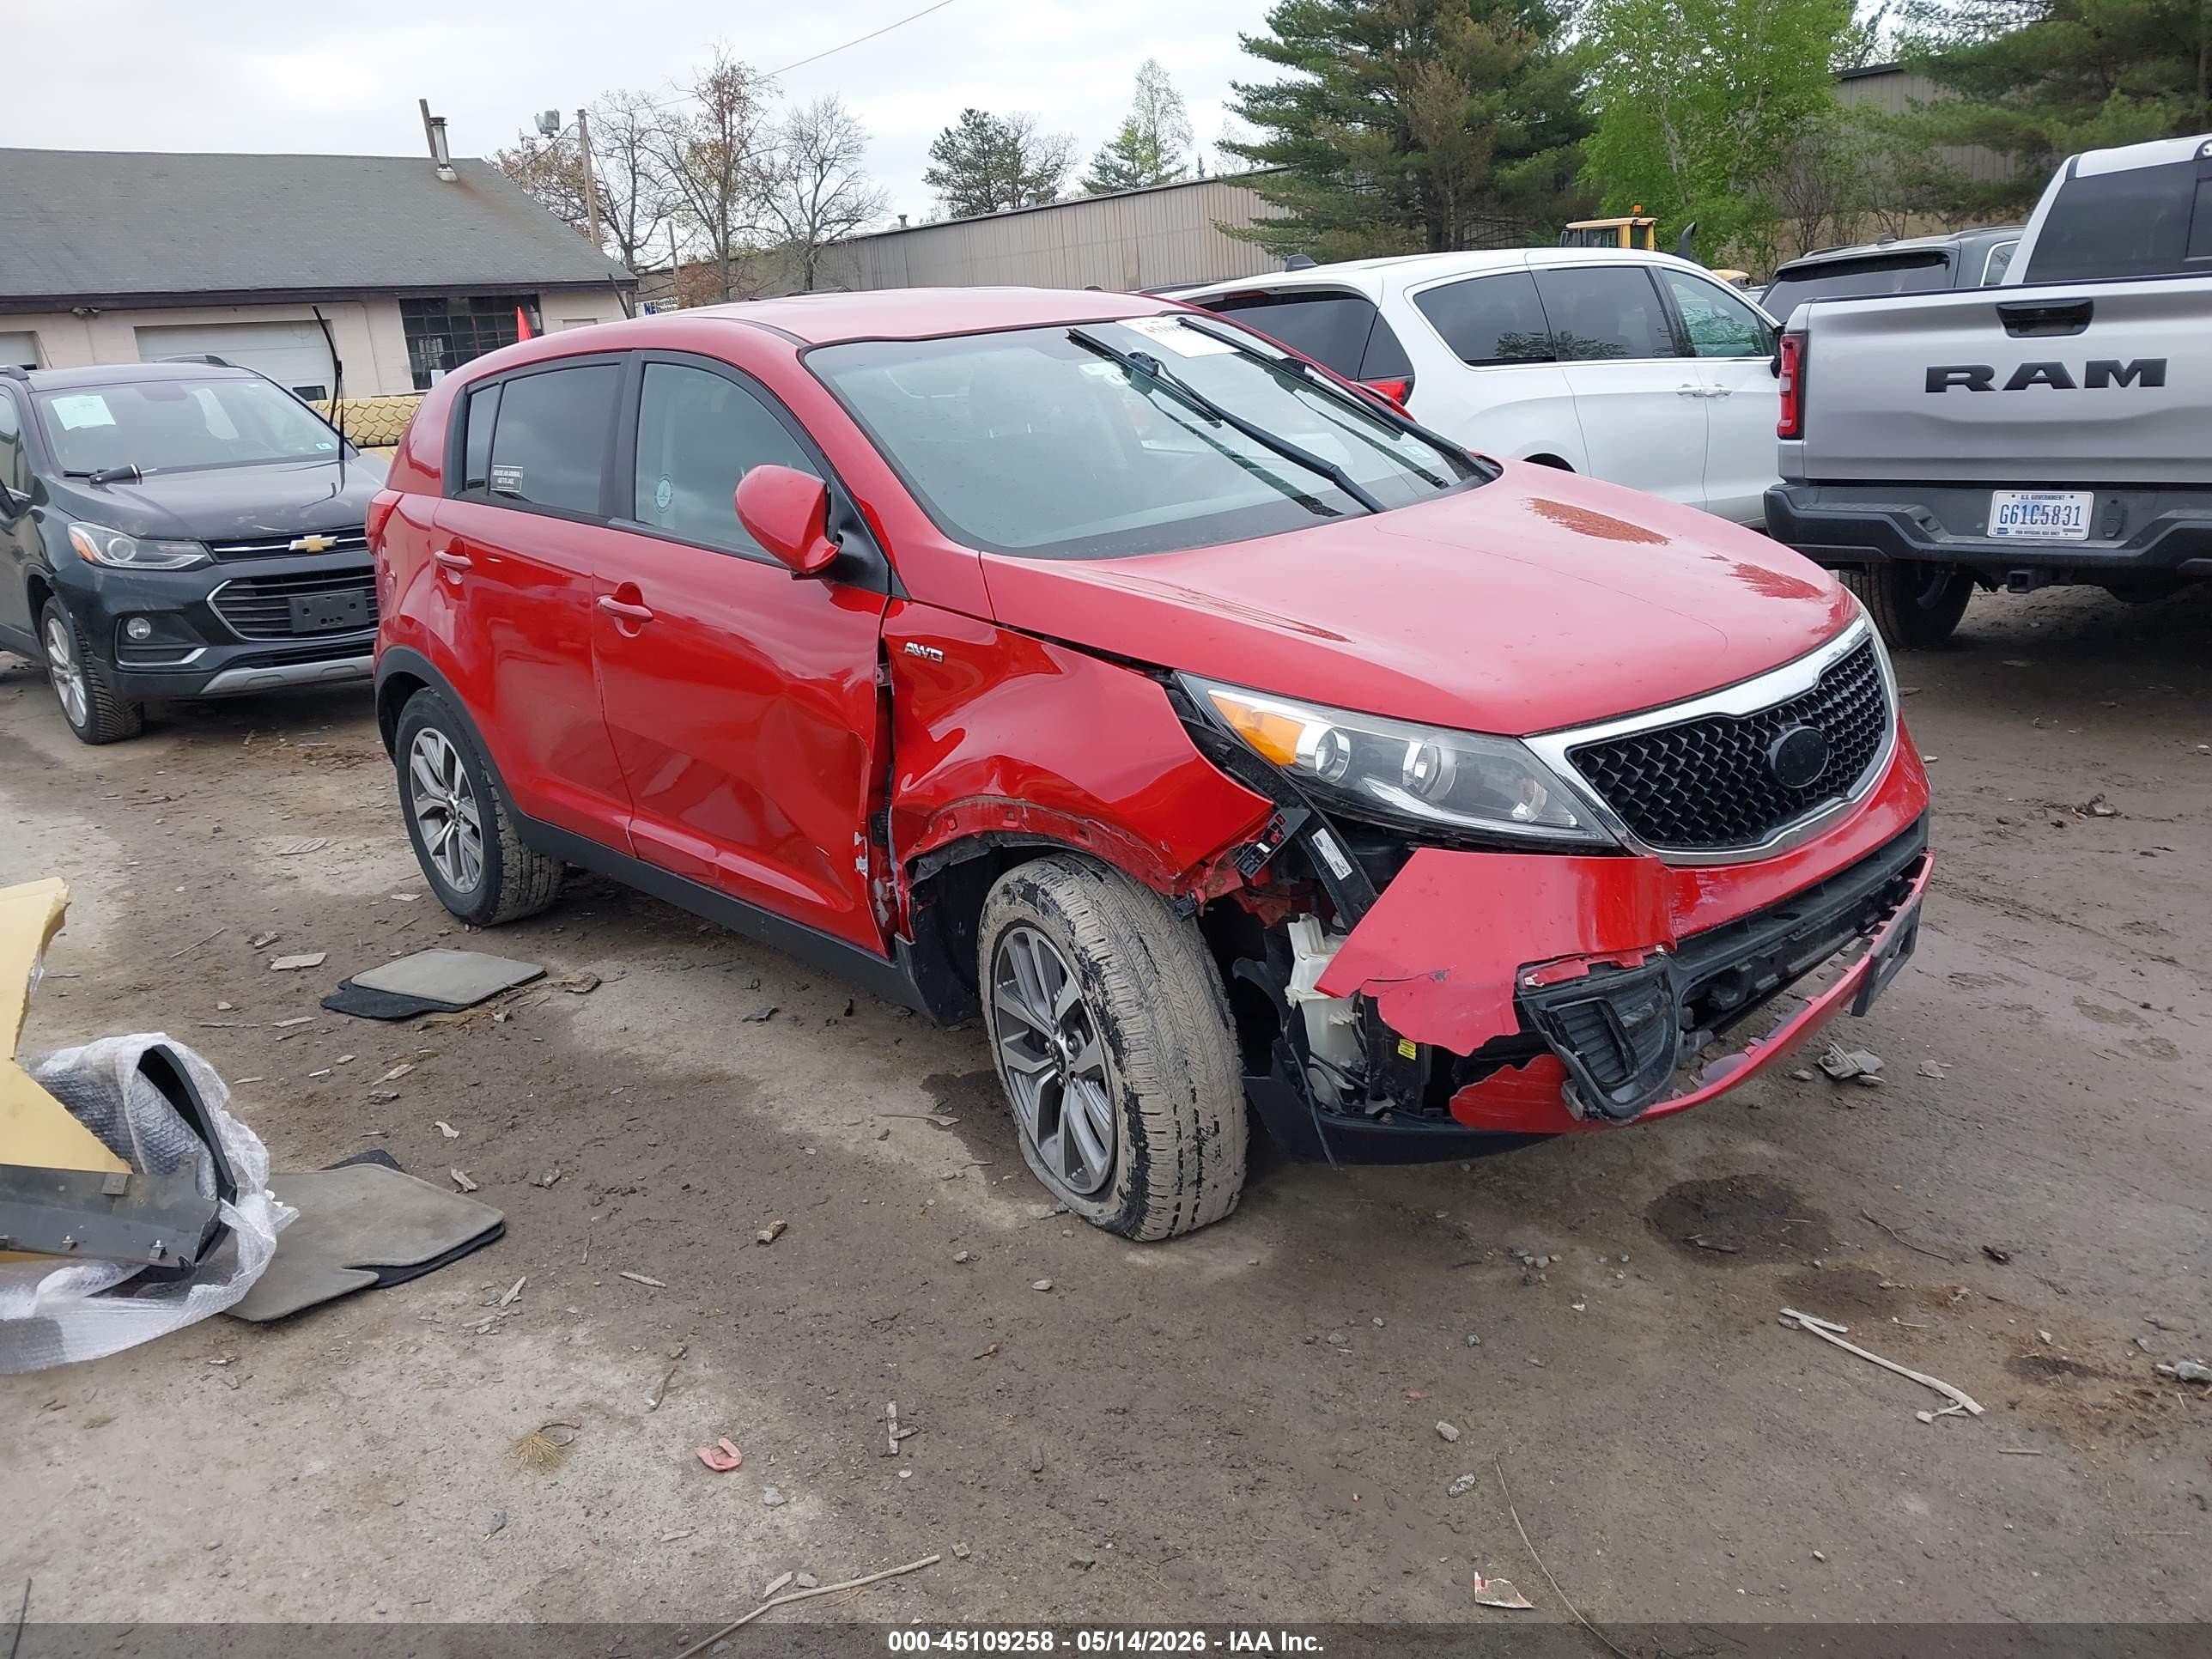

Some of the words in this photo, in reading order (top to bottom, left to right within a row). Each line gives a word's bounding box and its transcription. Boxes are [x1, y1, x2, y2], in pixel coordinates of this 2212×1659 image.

[1925, 358, 2167, 393] RAM
[2000, 504, 2081, 526] G61C5831
[904, 641, 944, 663] AWD
